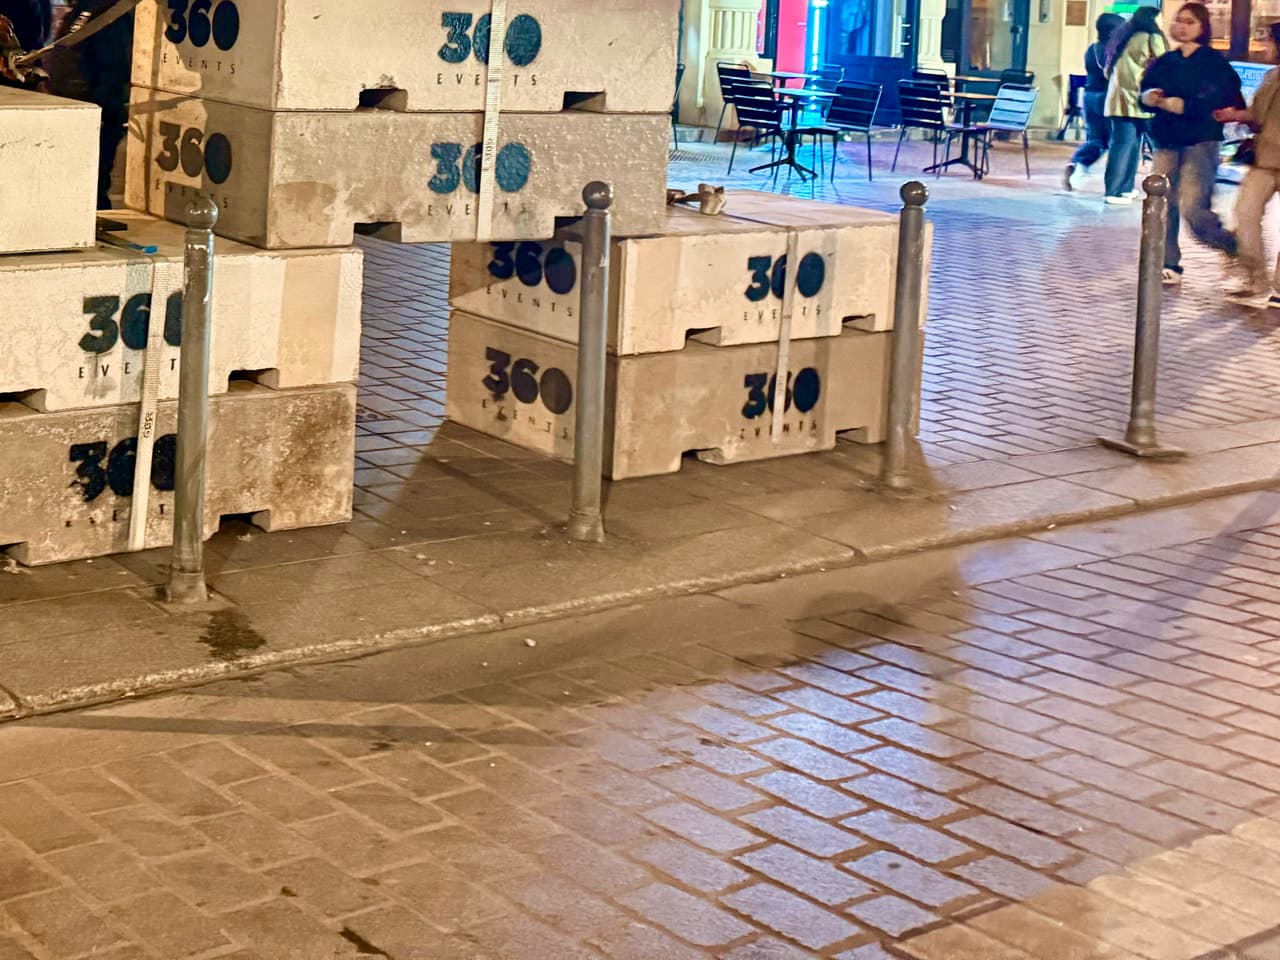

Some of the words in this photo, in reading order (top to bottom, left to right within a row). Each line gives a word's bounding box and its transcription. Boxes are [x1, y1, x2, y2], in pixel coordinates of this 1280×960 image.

[161, 52, 236, 75] EVENTS
[437, 73, 537, 86] EVETS
[155, 120, 232, 185] 360
[427, 202, 528, 217] EVETS
[487, 240, 577, 296] 360
[743, 304, 822, 323] EVETS
[78, 358, 177, 379] EVET
[482, 346, 573, 415] 360
